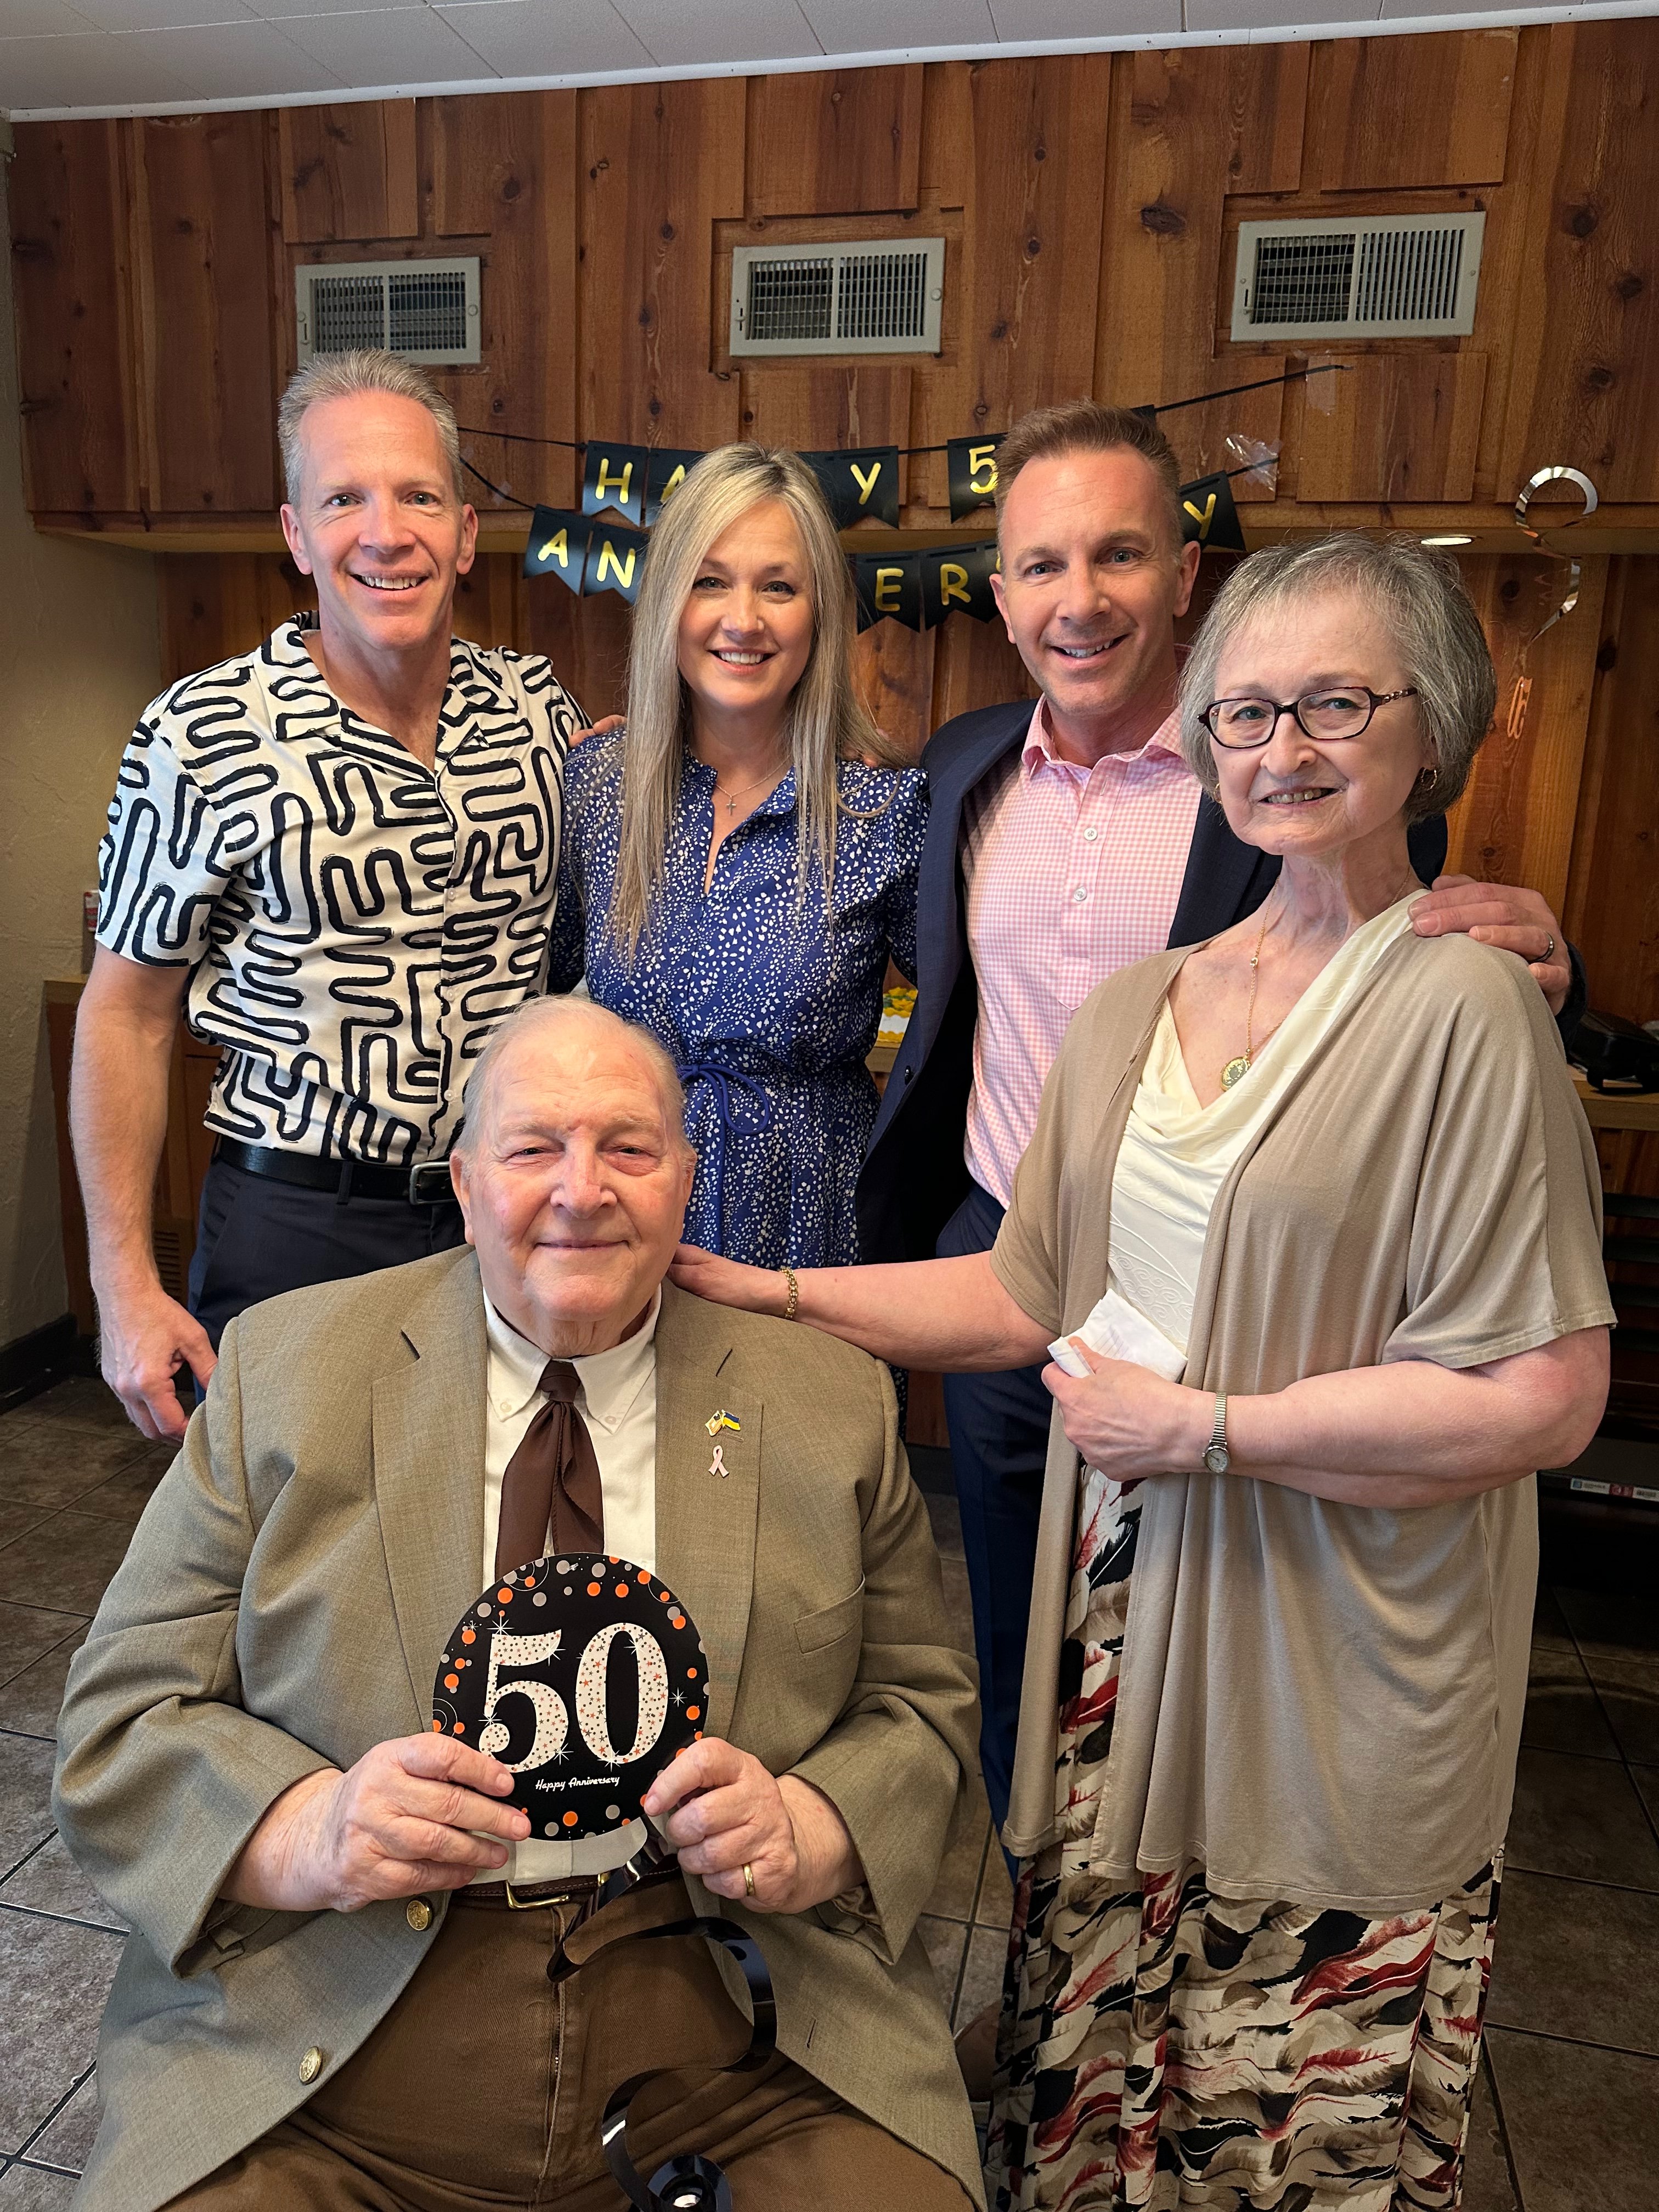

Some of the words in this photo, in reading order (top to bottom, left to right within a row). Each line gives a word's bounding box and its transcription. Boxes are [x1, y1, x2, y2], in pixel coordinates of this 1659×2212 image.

[478, 1622, 668, 1773] 50
[535, 1779, 566, 1792] Happy
[568, 1776, 620, 1787] Anniversary
